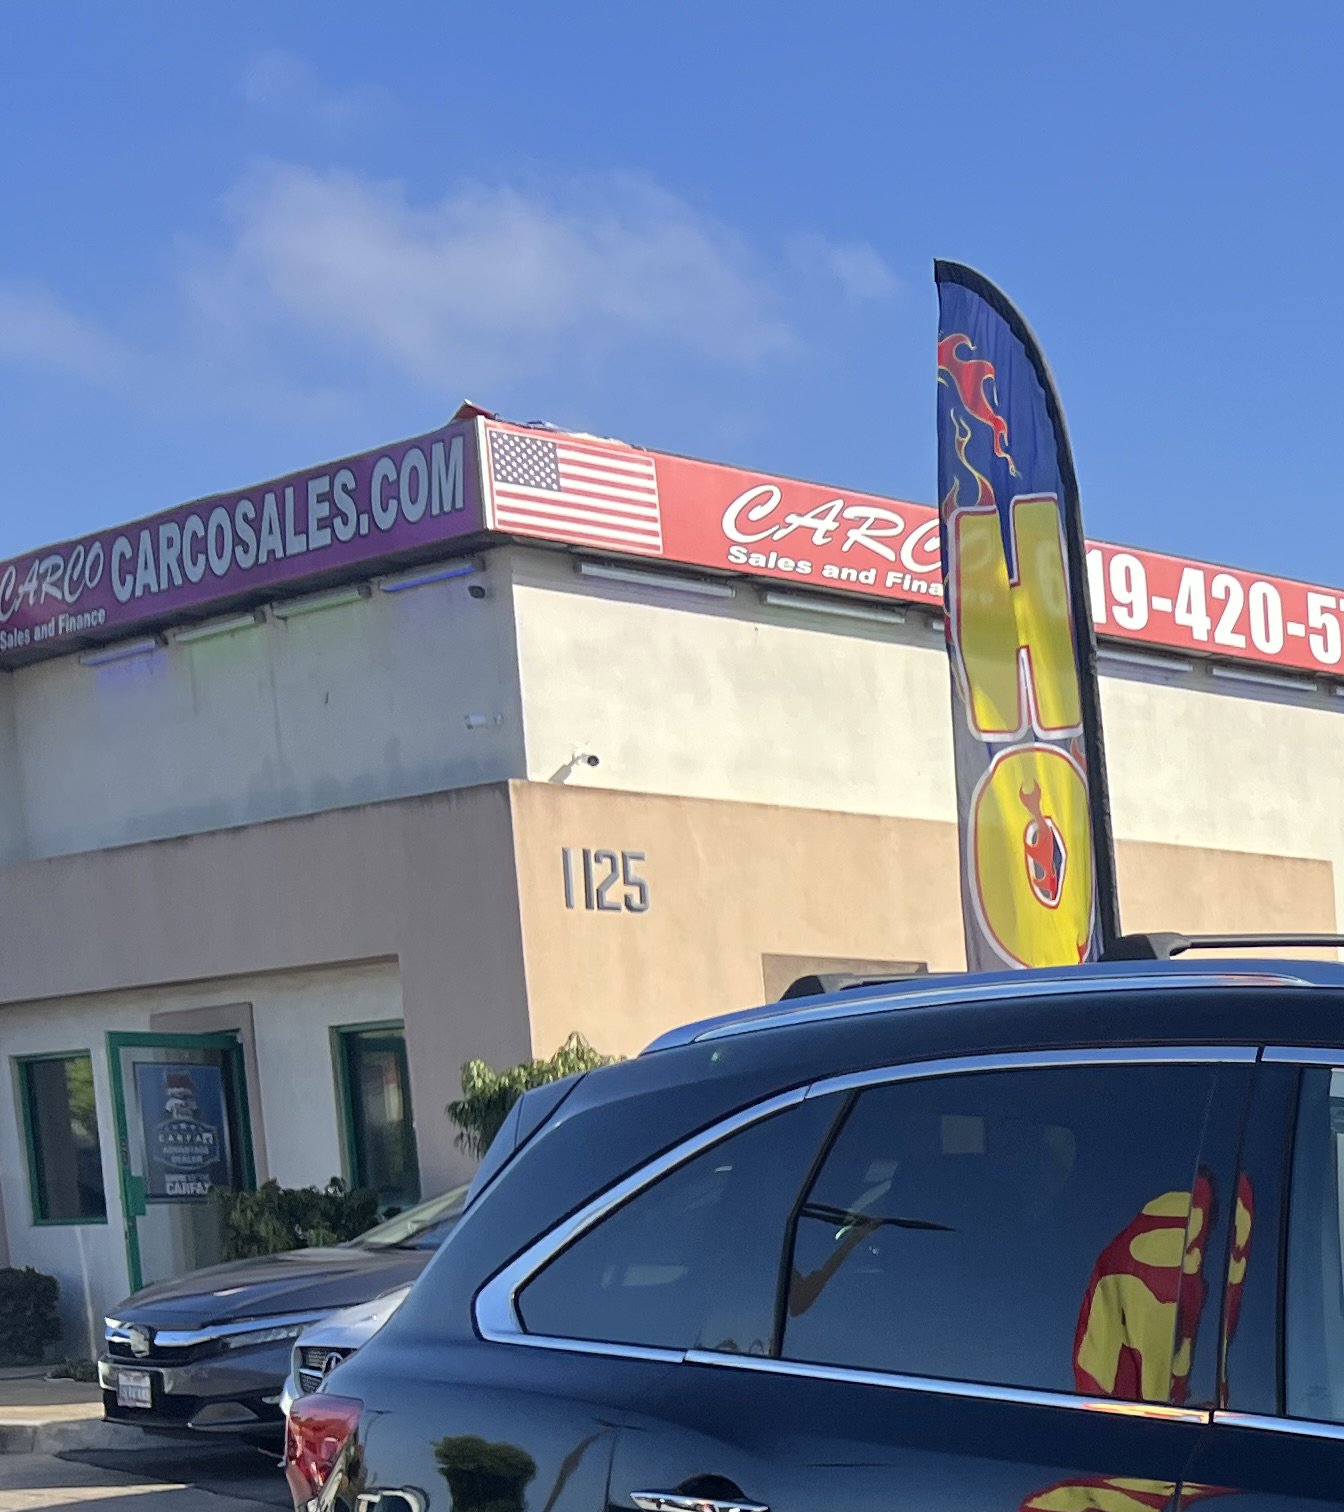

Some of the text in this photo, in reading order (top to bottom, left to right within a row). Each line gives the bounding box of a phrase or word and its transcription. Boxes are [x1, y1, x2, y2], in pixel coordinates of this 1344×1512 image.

[111, 436, 465, 603] CARCOSALES.COM
[721, 484, 942, 574] CARC
[0, 541, 105, 622] CARCO
[727, 545, 944, 597] Sales and Fina
[0, 607, 106, 651] Sales and Finance
[561, 846, 650, 913] 1125
